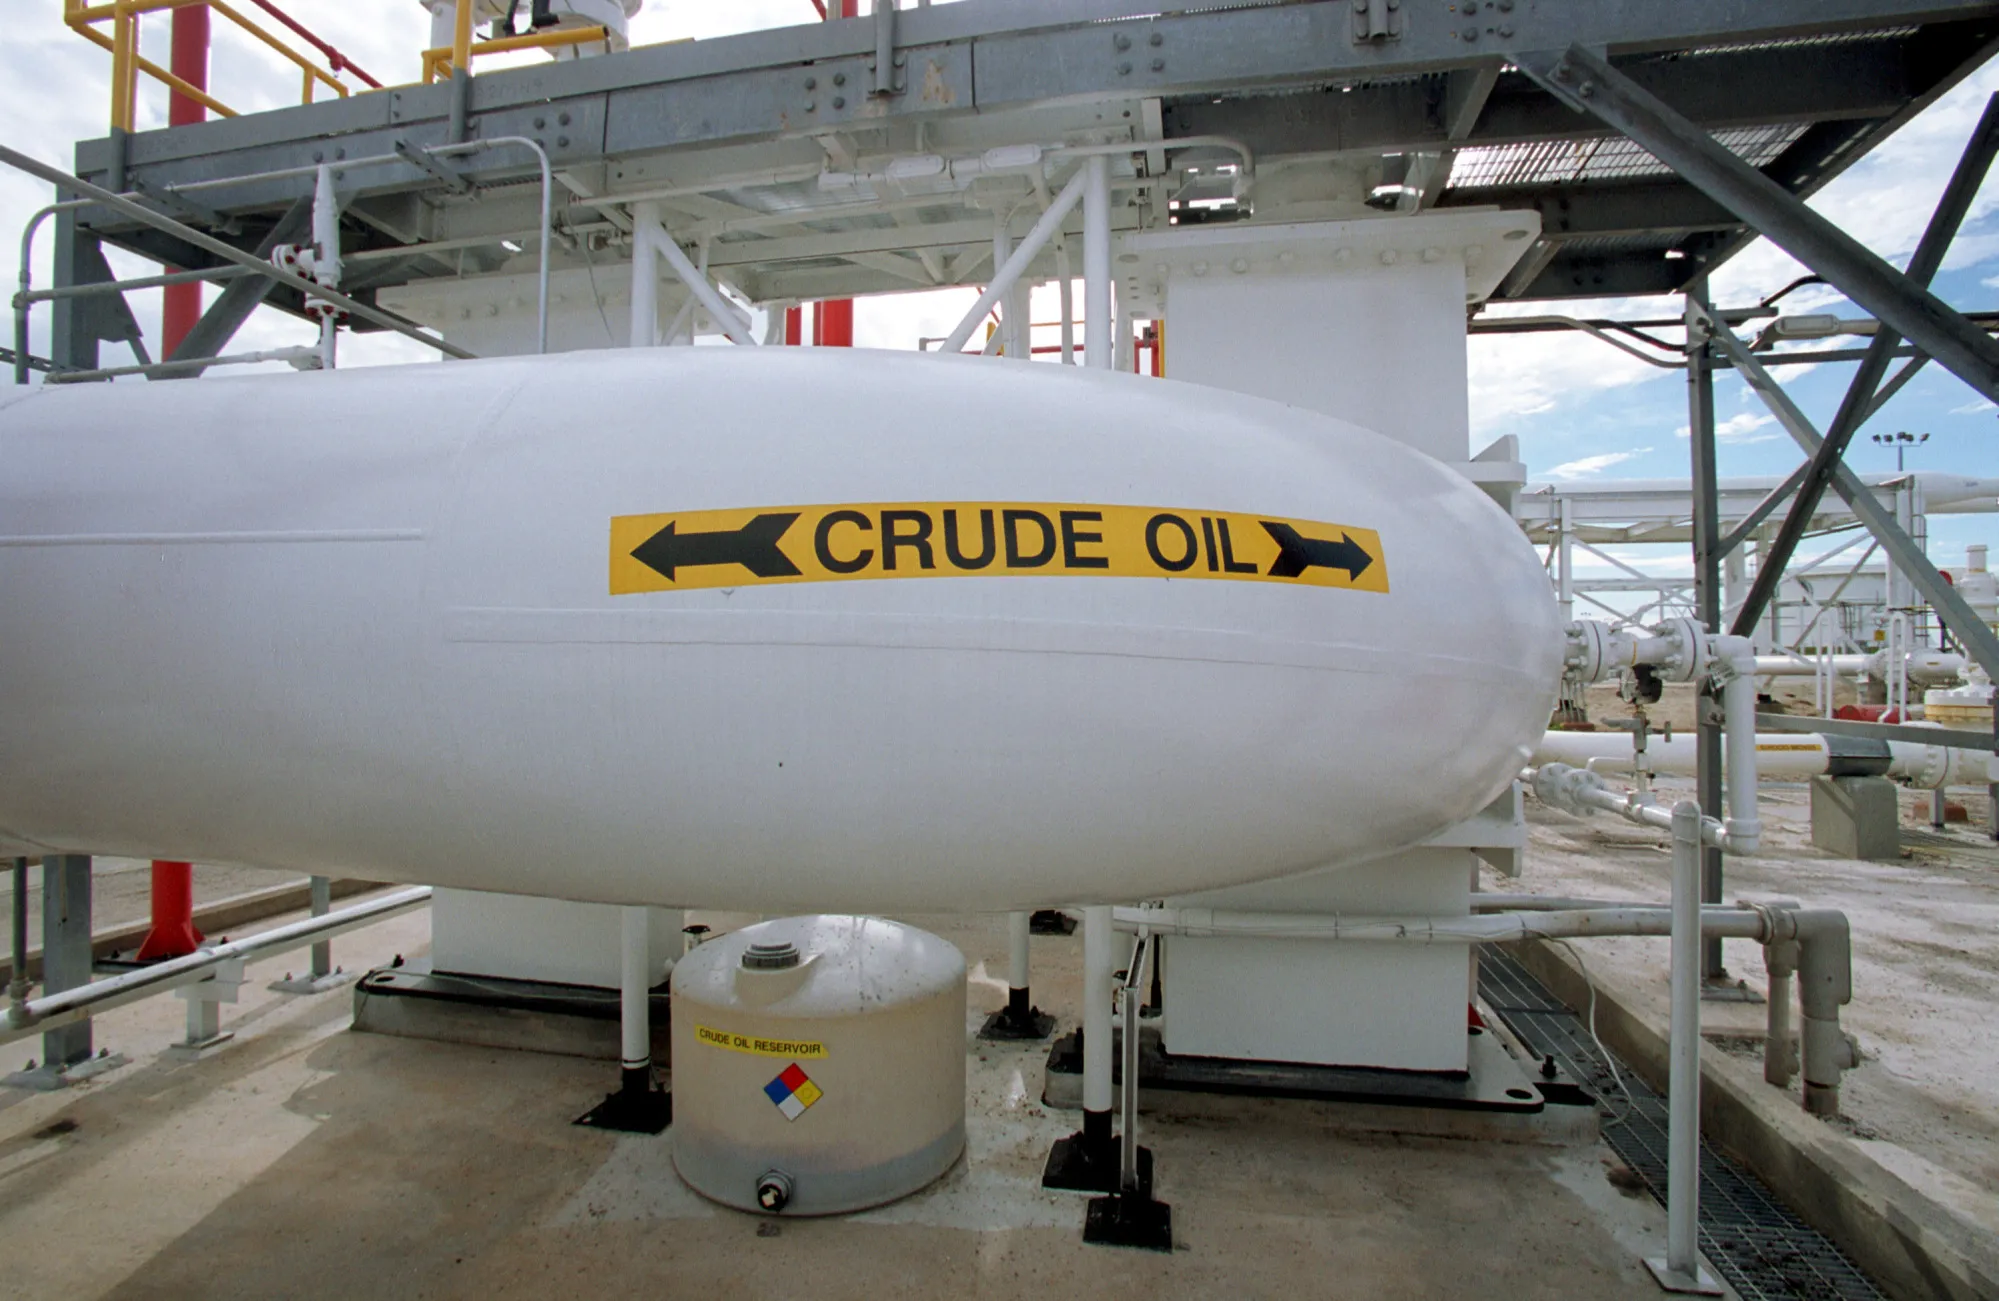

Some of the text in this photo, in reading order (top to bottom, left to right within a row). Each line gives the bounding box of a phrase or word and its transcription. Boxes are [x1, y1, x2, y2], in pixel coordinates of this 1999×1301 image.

[814, 508, 1258, 574] CRUDE OIL
[699, 1028, 821, 1055] CRUDE OIL RESERVOIR
